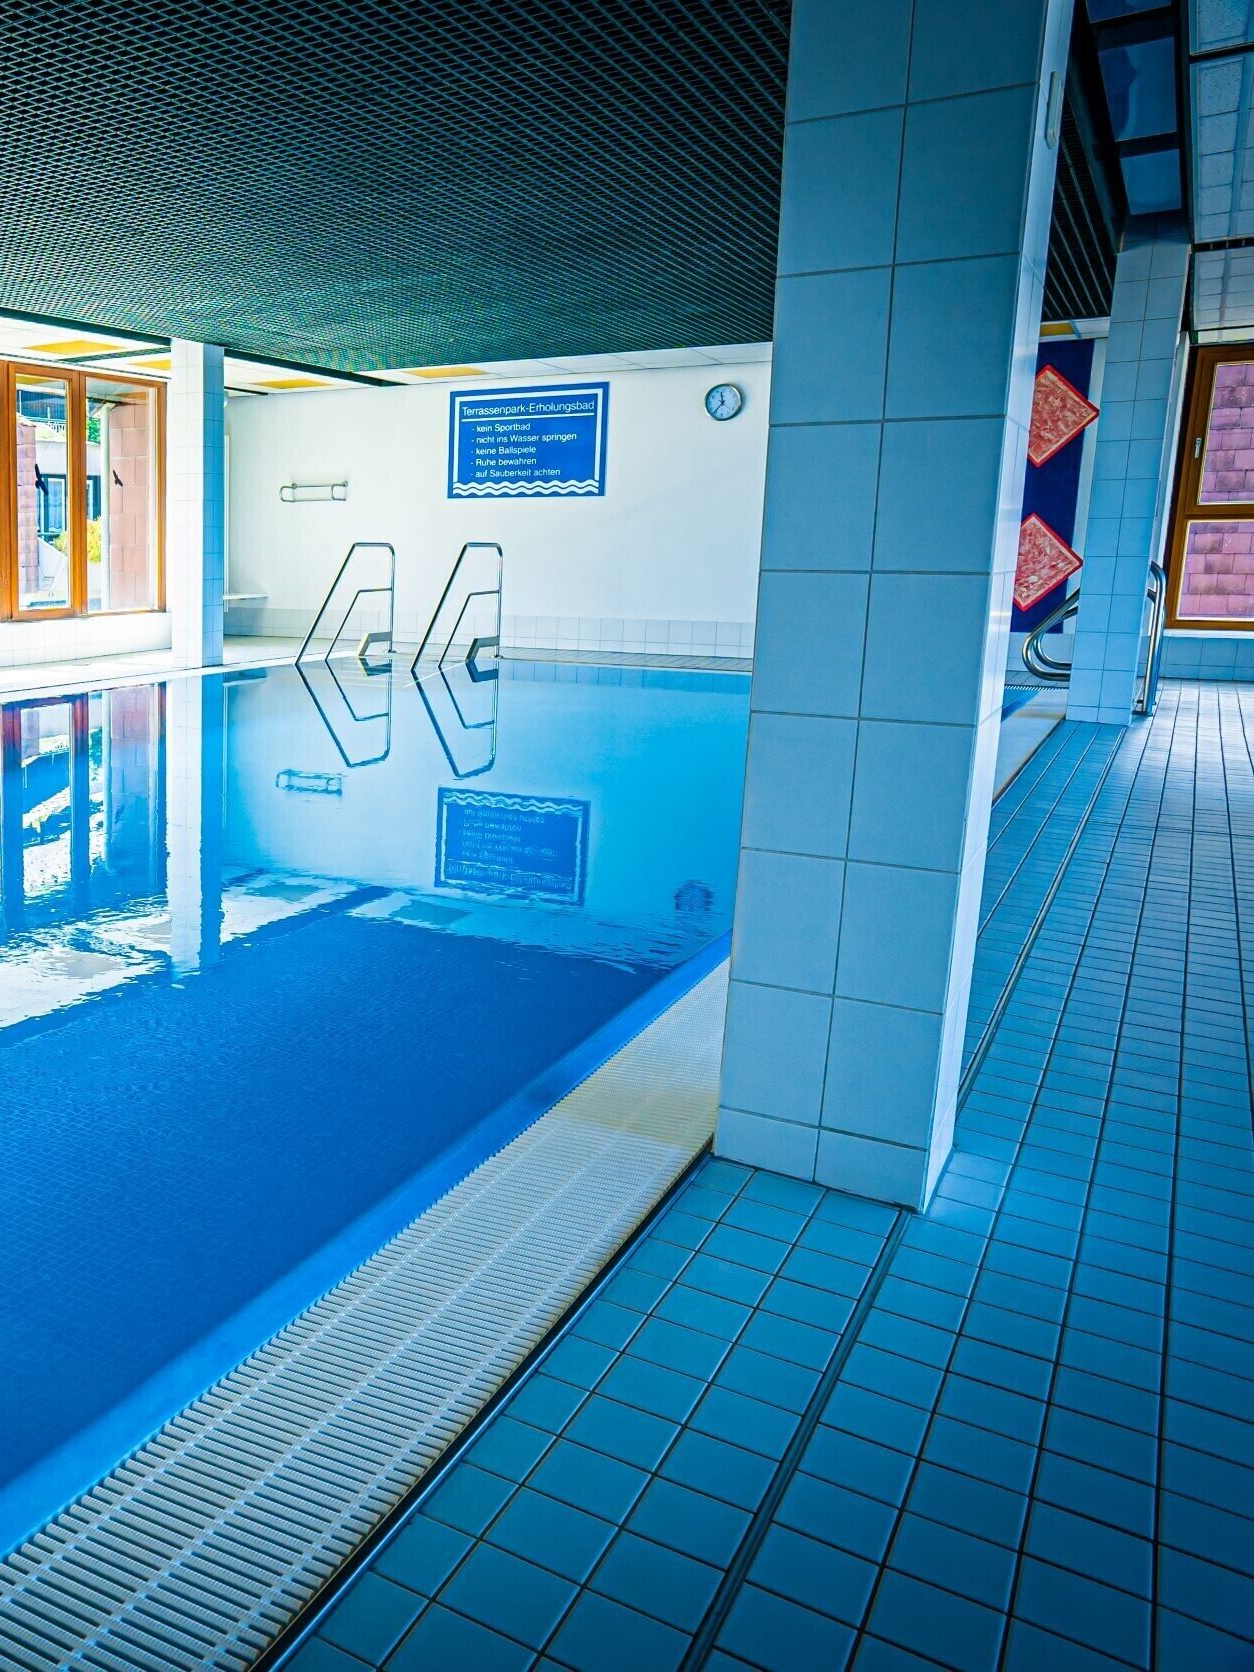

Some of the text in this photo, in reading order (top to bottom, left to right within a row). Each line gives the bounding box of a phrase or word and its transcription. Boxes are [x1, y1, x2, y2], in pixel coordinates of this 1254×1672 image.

[462, 401, 594, 416] Terrassenpark-Erholungsbad
[476, 423, 531, 433] kein Sportbad
[476, 436, 495, 444] nicht
[510, 434, 539, 442] Wasser
[541, 433, 577, 443] springen
[476, 446, 537, 456] keine Ballspiele
[476, 457, 537, 466] Ruhe bewahren
[475, 468, 560, 478] auf Sauberkeit achten
